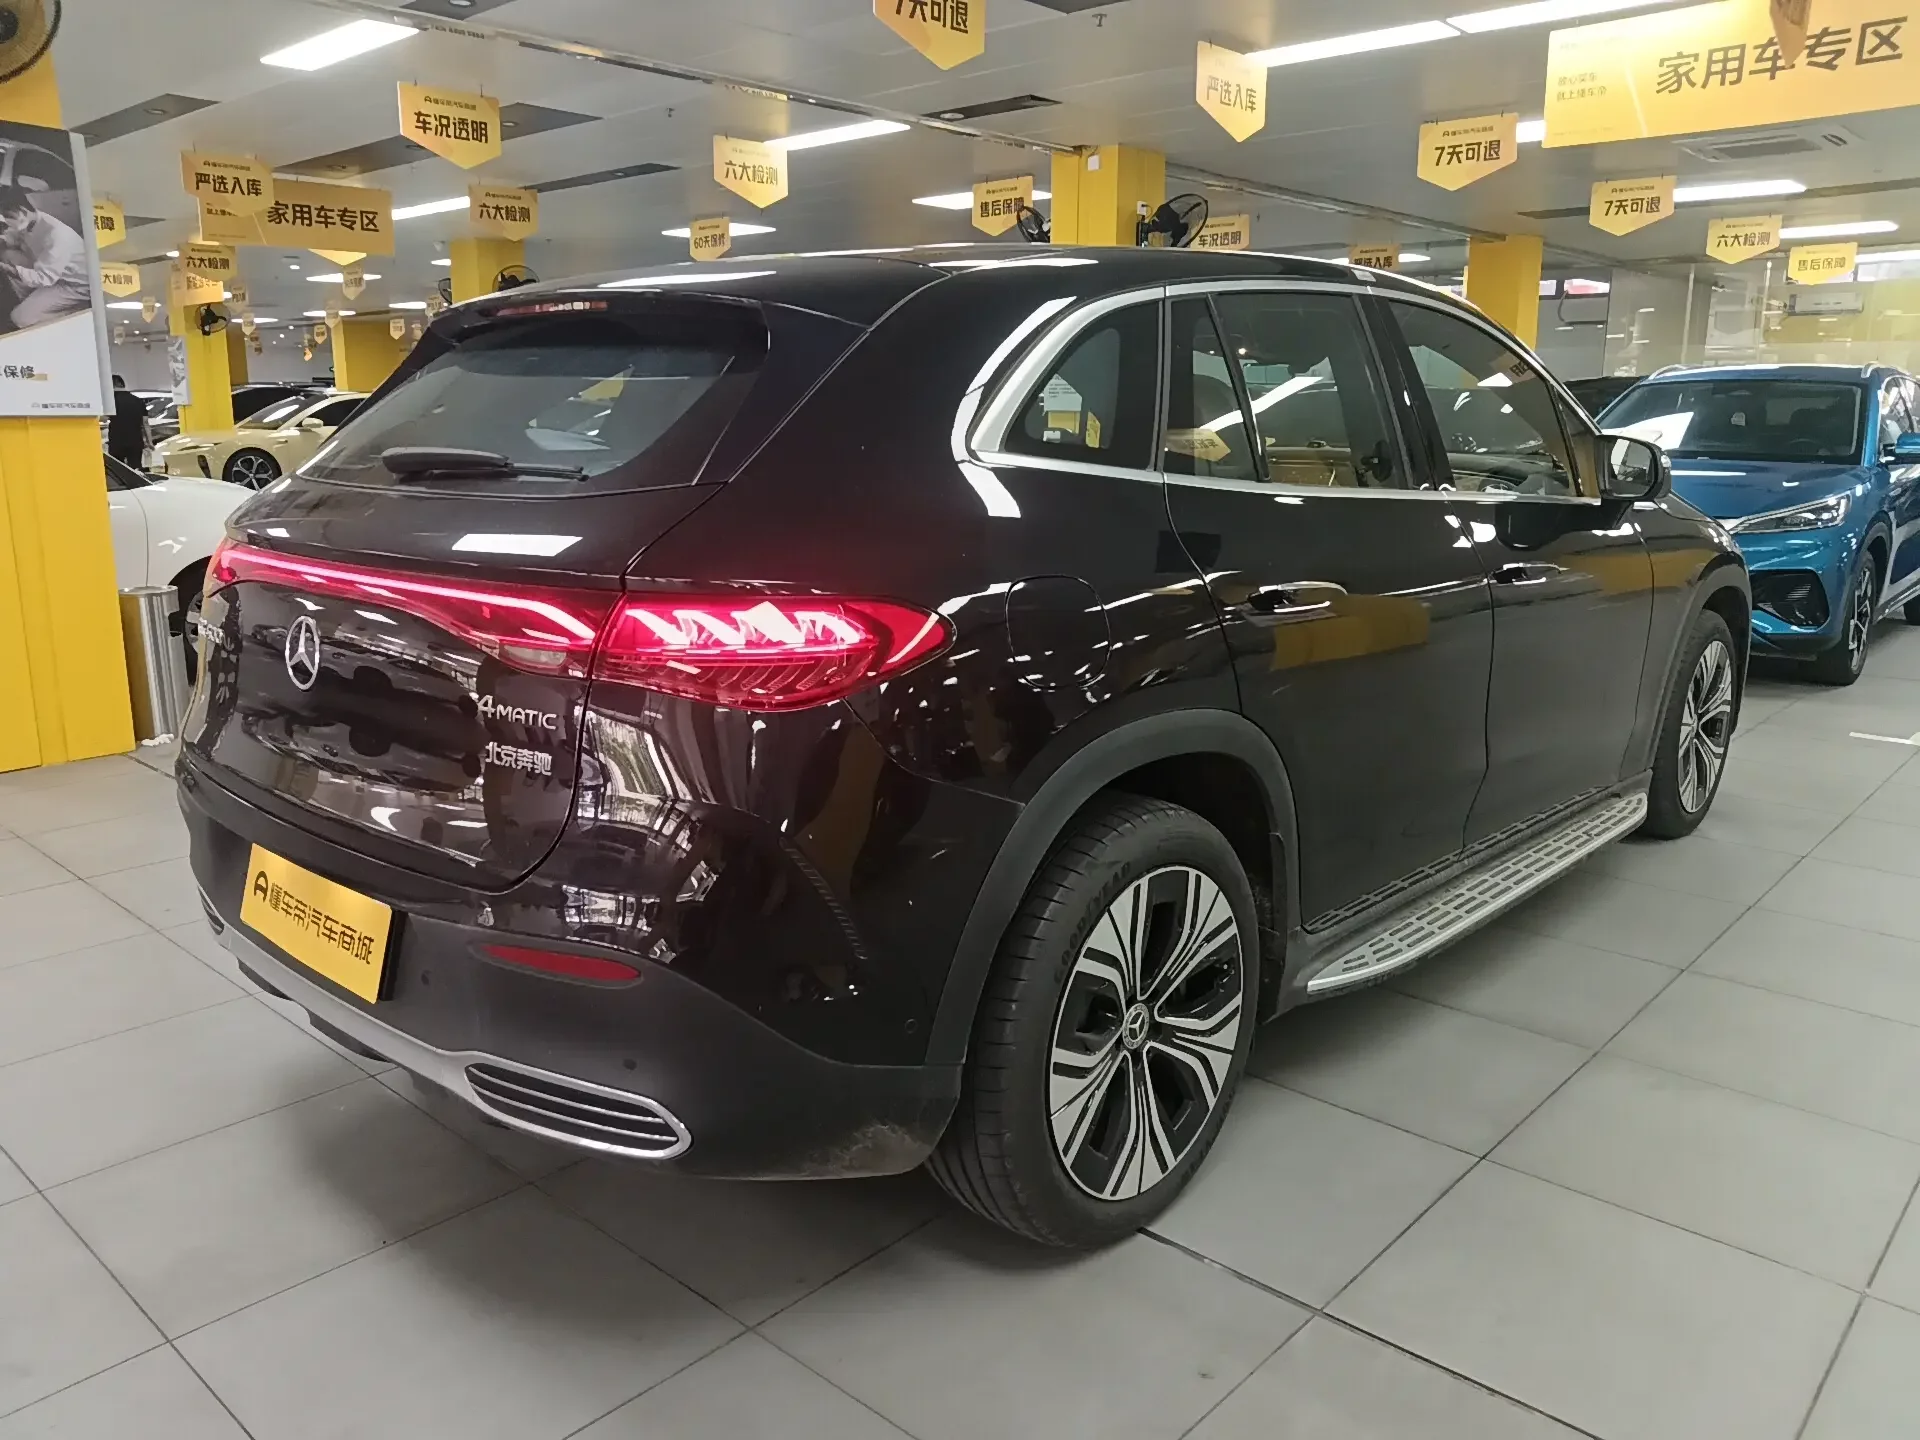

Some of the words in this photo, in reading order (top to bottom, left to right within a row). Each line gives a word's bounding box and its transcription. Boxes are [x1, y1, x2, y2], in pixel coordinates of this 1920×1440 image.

[1655, 15, 1908, 94] 家用车专区
[1206, 75, 1257, 113] 严选入库
[414, 110, 489, 144] 车况透明
[1434, 139, 1501, 166] 7天可退
[194, 172, 263, 197] 严选入库
[724, 160, 778, 186] 六大检测
[267, 200, 380, 232] 家用车专区
[478, 202, 531, 223] 六大检测
[980, 196, 1025, 218] 售后保障
[1604, 196, 1661, 217] 7天可退
[1198, 231, 1242, 247] 车况透明
[1716, 231, 1771, 248] 六大检测
[186, 256, 230, 270] 六大检测
[1797, 256, 1847, 272] 售后保障
[0, 365, 35, 379] 保修
[477, 694, 557, 730] 4MATIC
[485, 741, 552, 776] 北京奔驰
[269, 882, 375, 965] 懂车帝汽车商城
